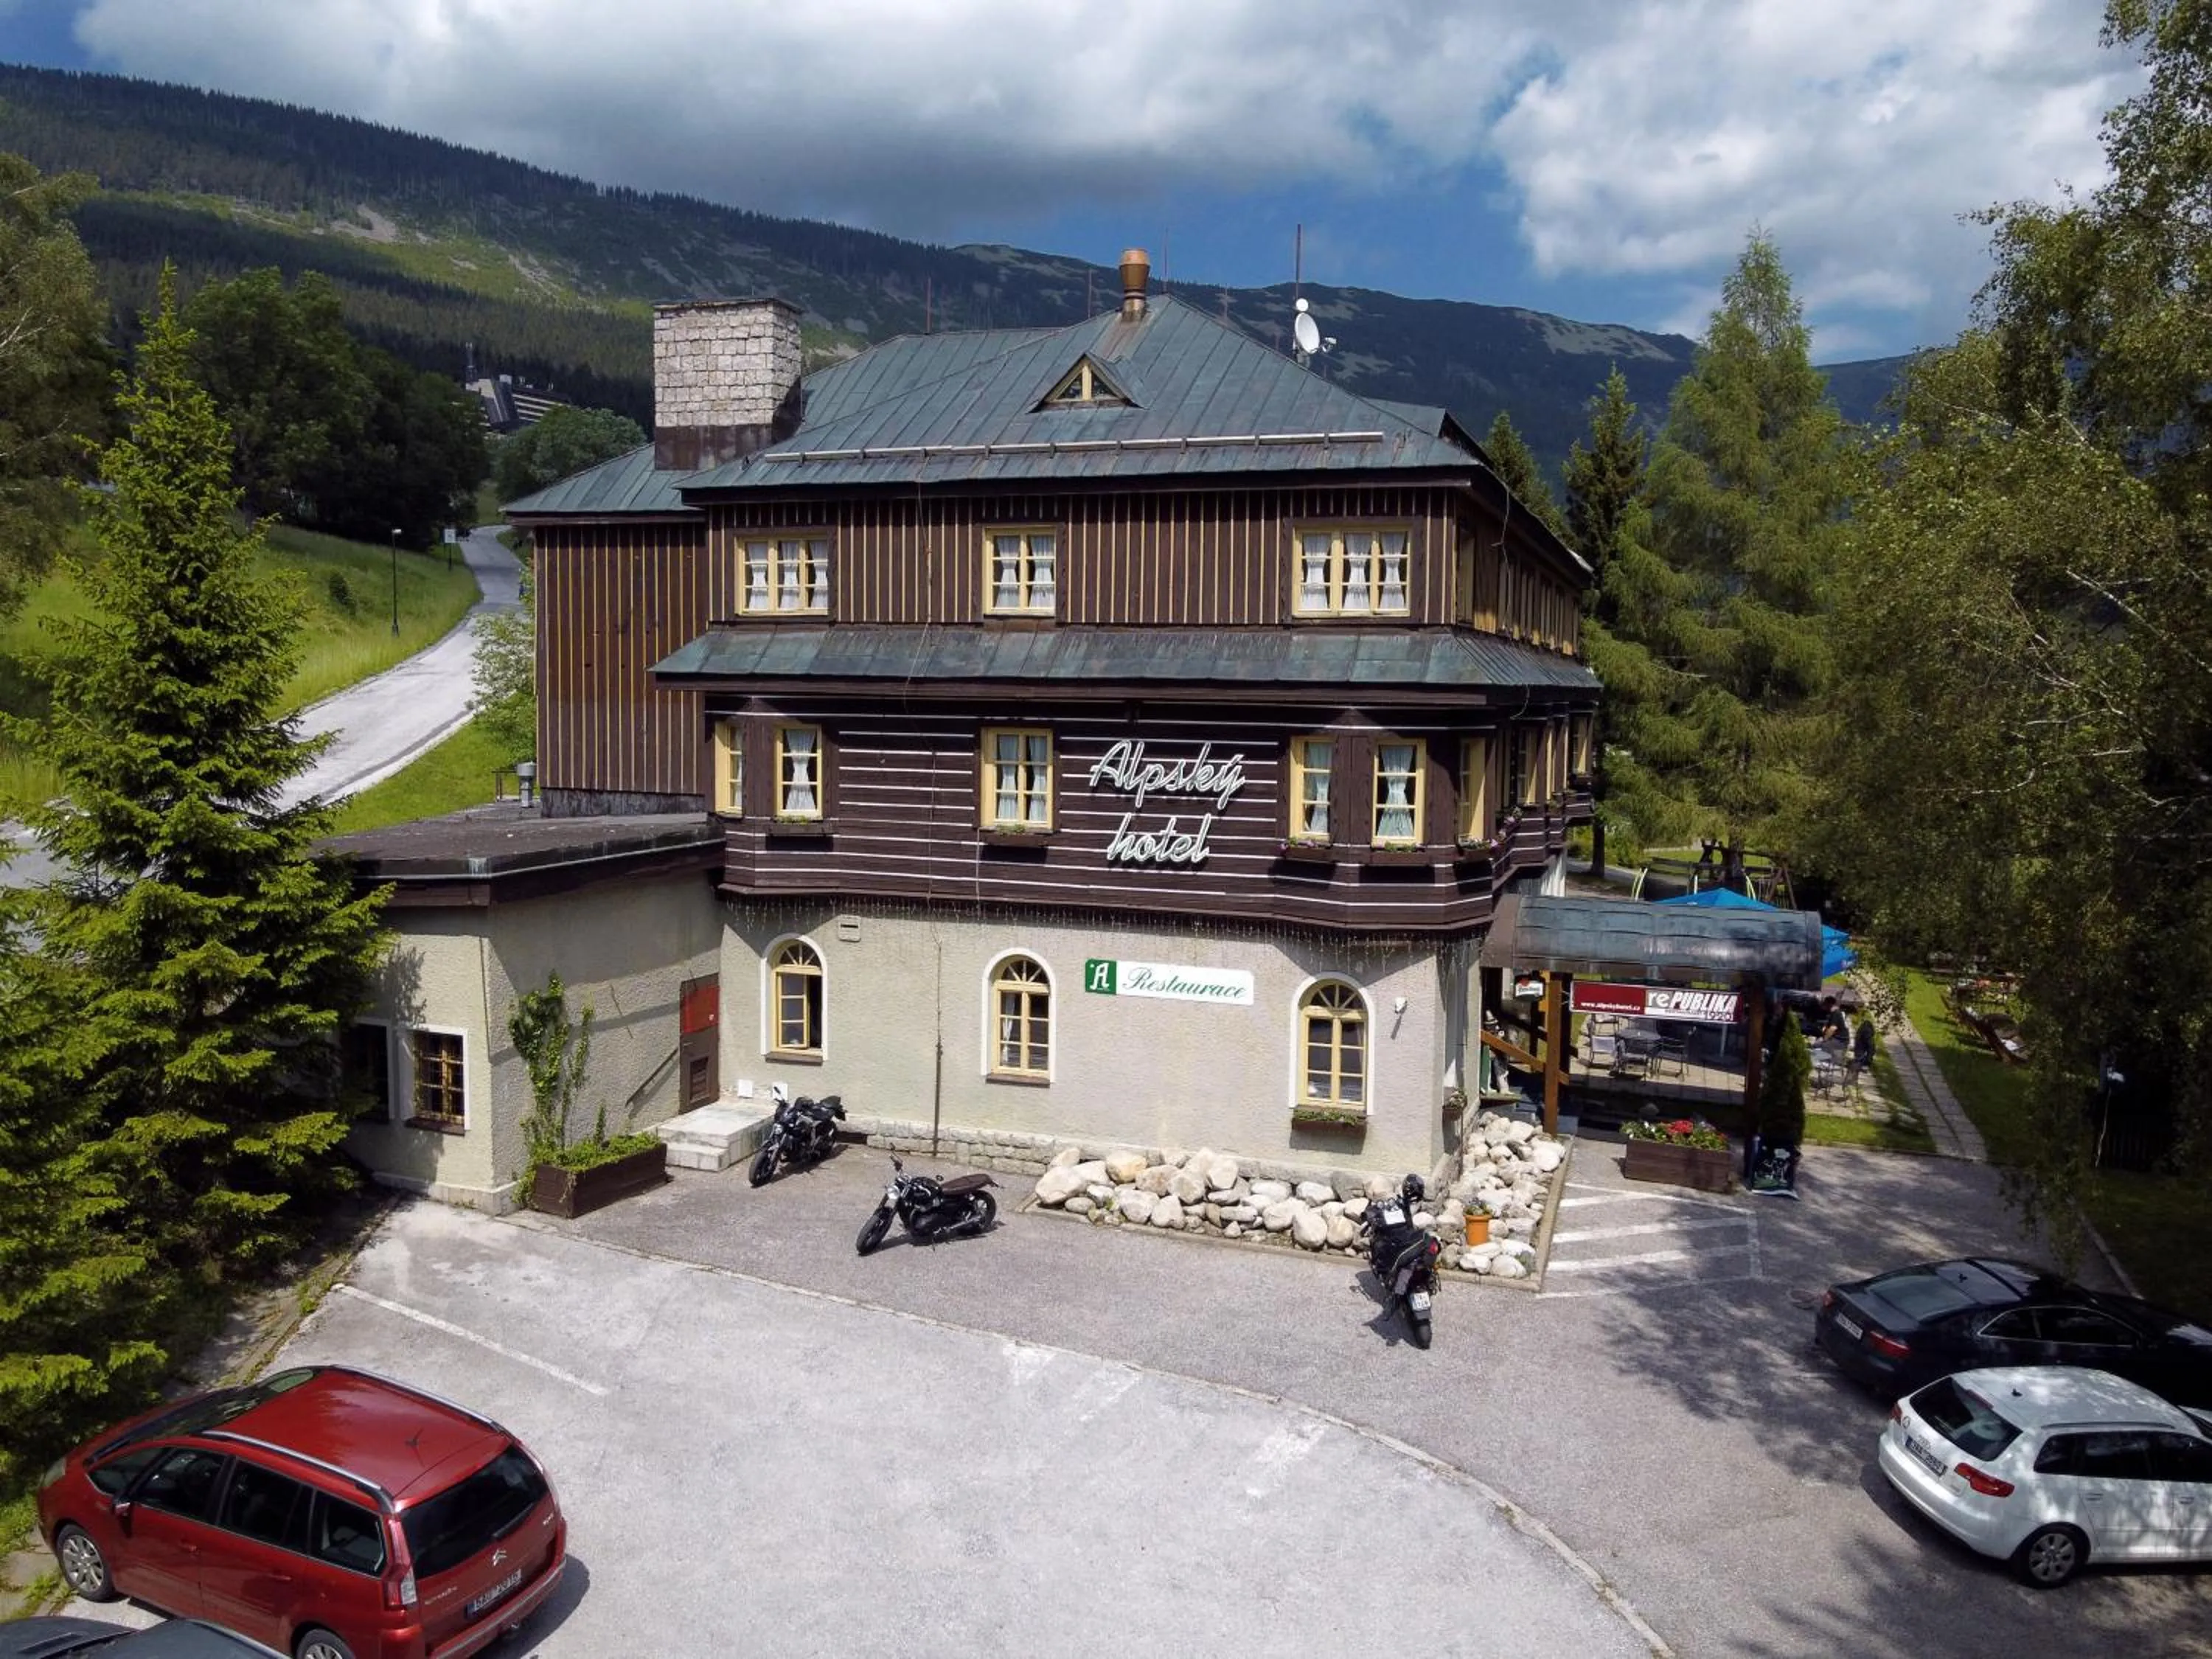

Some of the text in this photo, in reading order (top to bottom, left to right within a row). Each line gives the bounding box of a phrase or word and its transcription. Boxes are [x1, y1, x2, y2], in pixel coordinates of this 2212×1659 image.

[1089, 740, 1245, 810] Alpský
[1107, 813, 1211, 863] hotel
[1122, 967, 1248, 998] Restaurace
